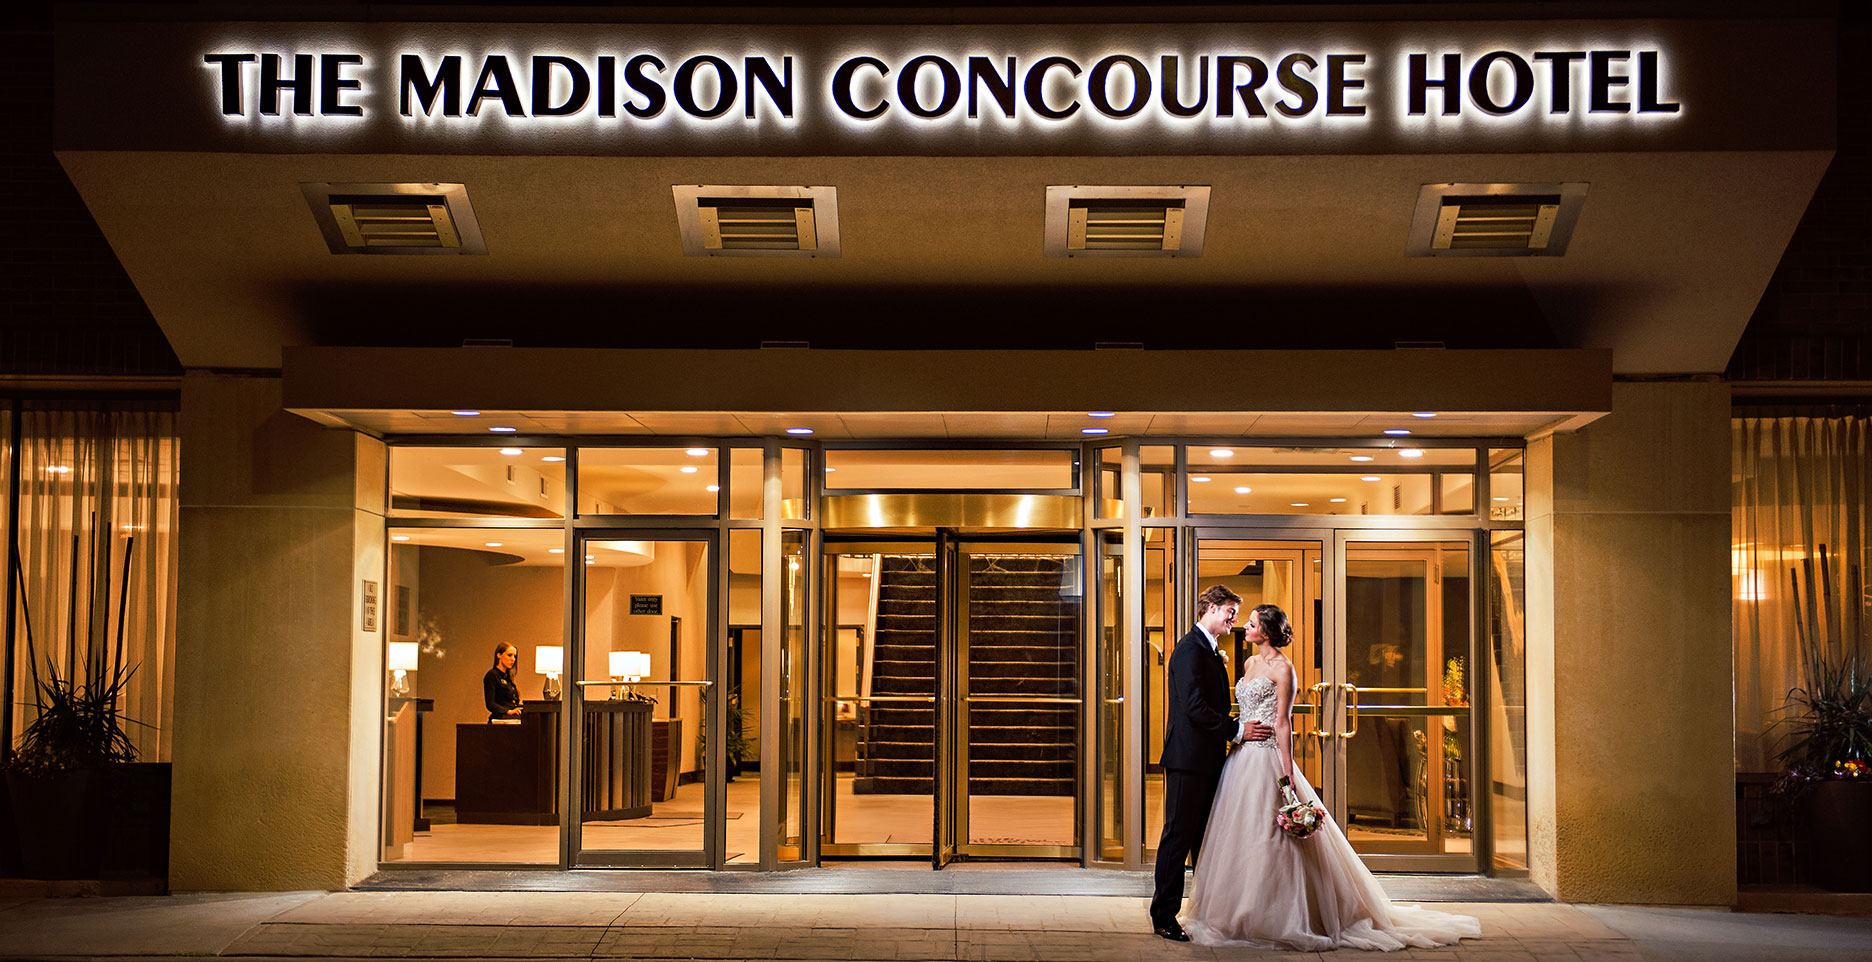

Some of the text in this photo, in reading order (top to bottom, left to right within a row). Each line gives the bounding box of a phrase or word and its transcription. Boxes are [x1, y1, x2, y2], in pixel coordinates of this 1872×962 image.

[204, 51, 1680, 119] THE MADISON CONCOURSE HOTEL
